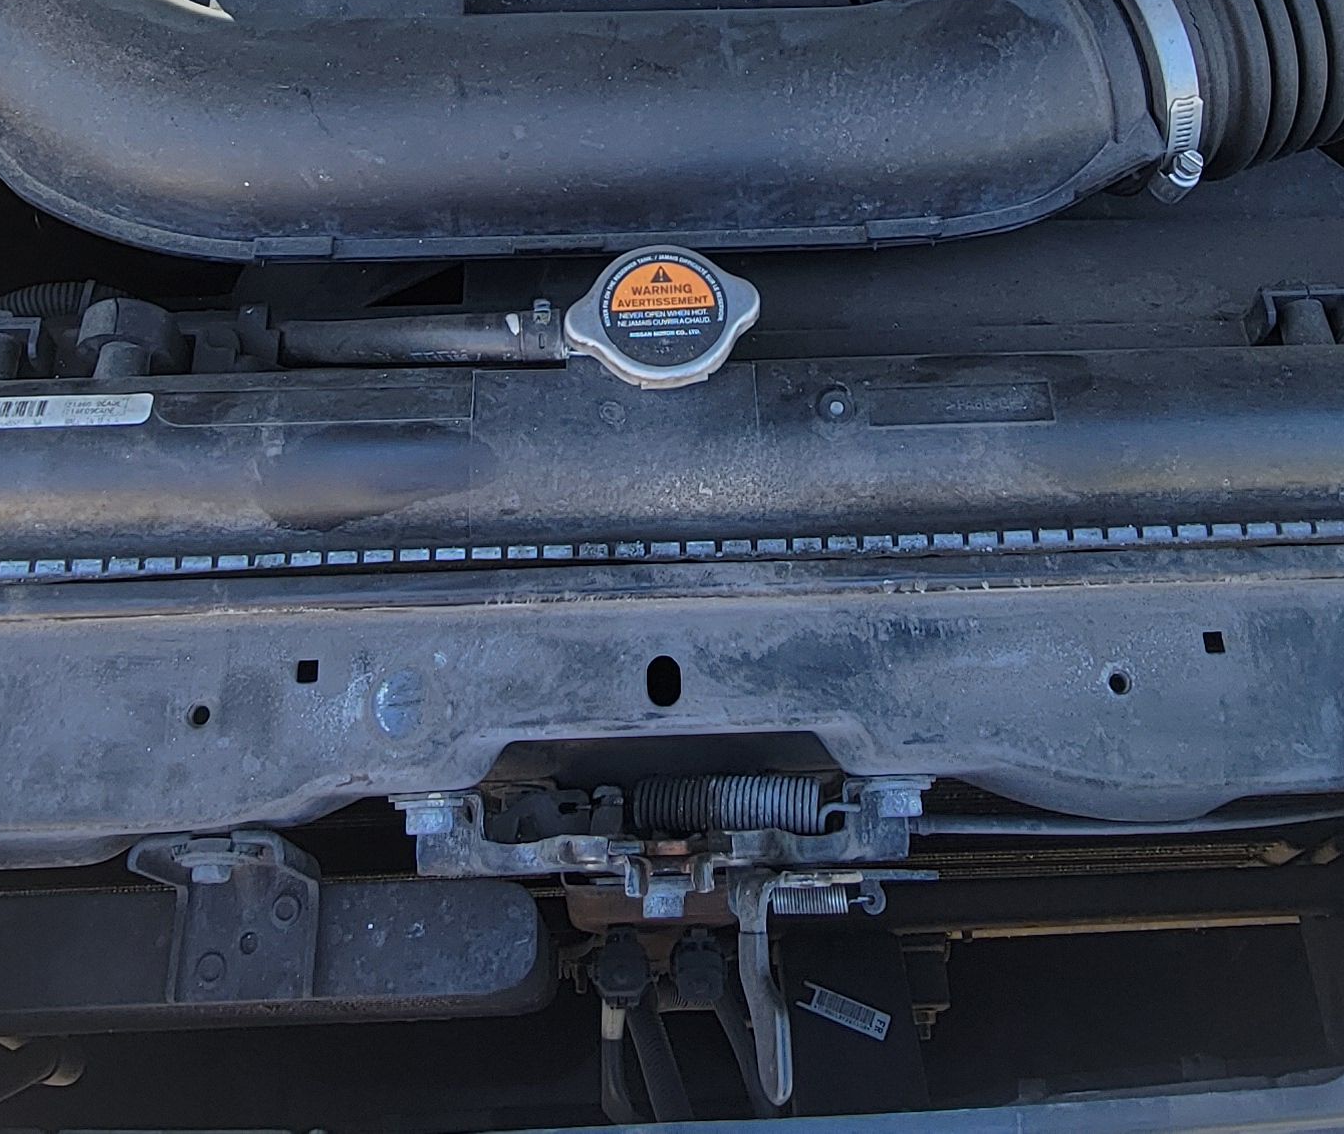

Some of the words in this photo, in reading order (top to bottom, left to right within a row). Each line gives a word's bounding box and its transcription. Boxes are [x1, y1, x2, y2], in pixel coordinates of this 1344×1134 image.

[631, 283, 693, 296] WARNING
[617, 295, 708, 308] AVERTISSEMENT
[645, 310, 666, 318] OPEN
[627, 319, 652, 327] JAMAIS
[685, 316, 711, 324] CHAUD.
[873, 1018, 886, 1035] FR
